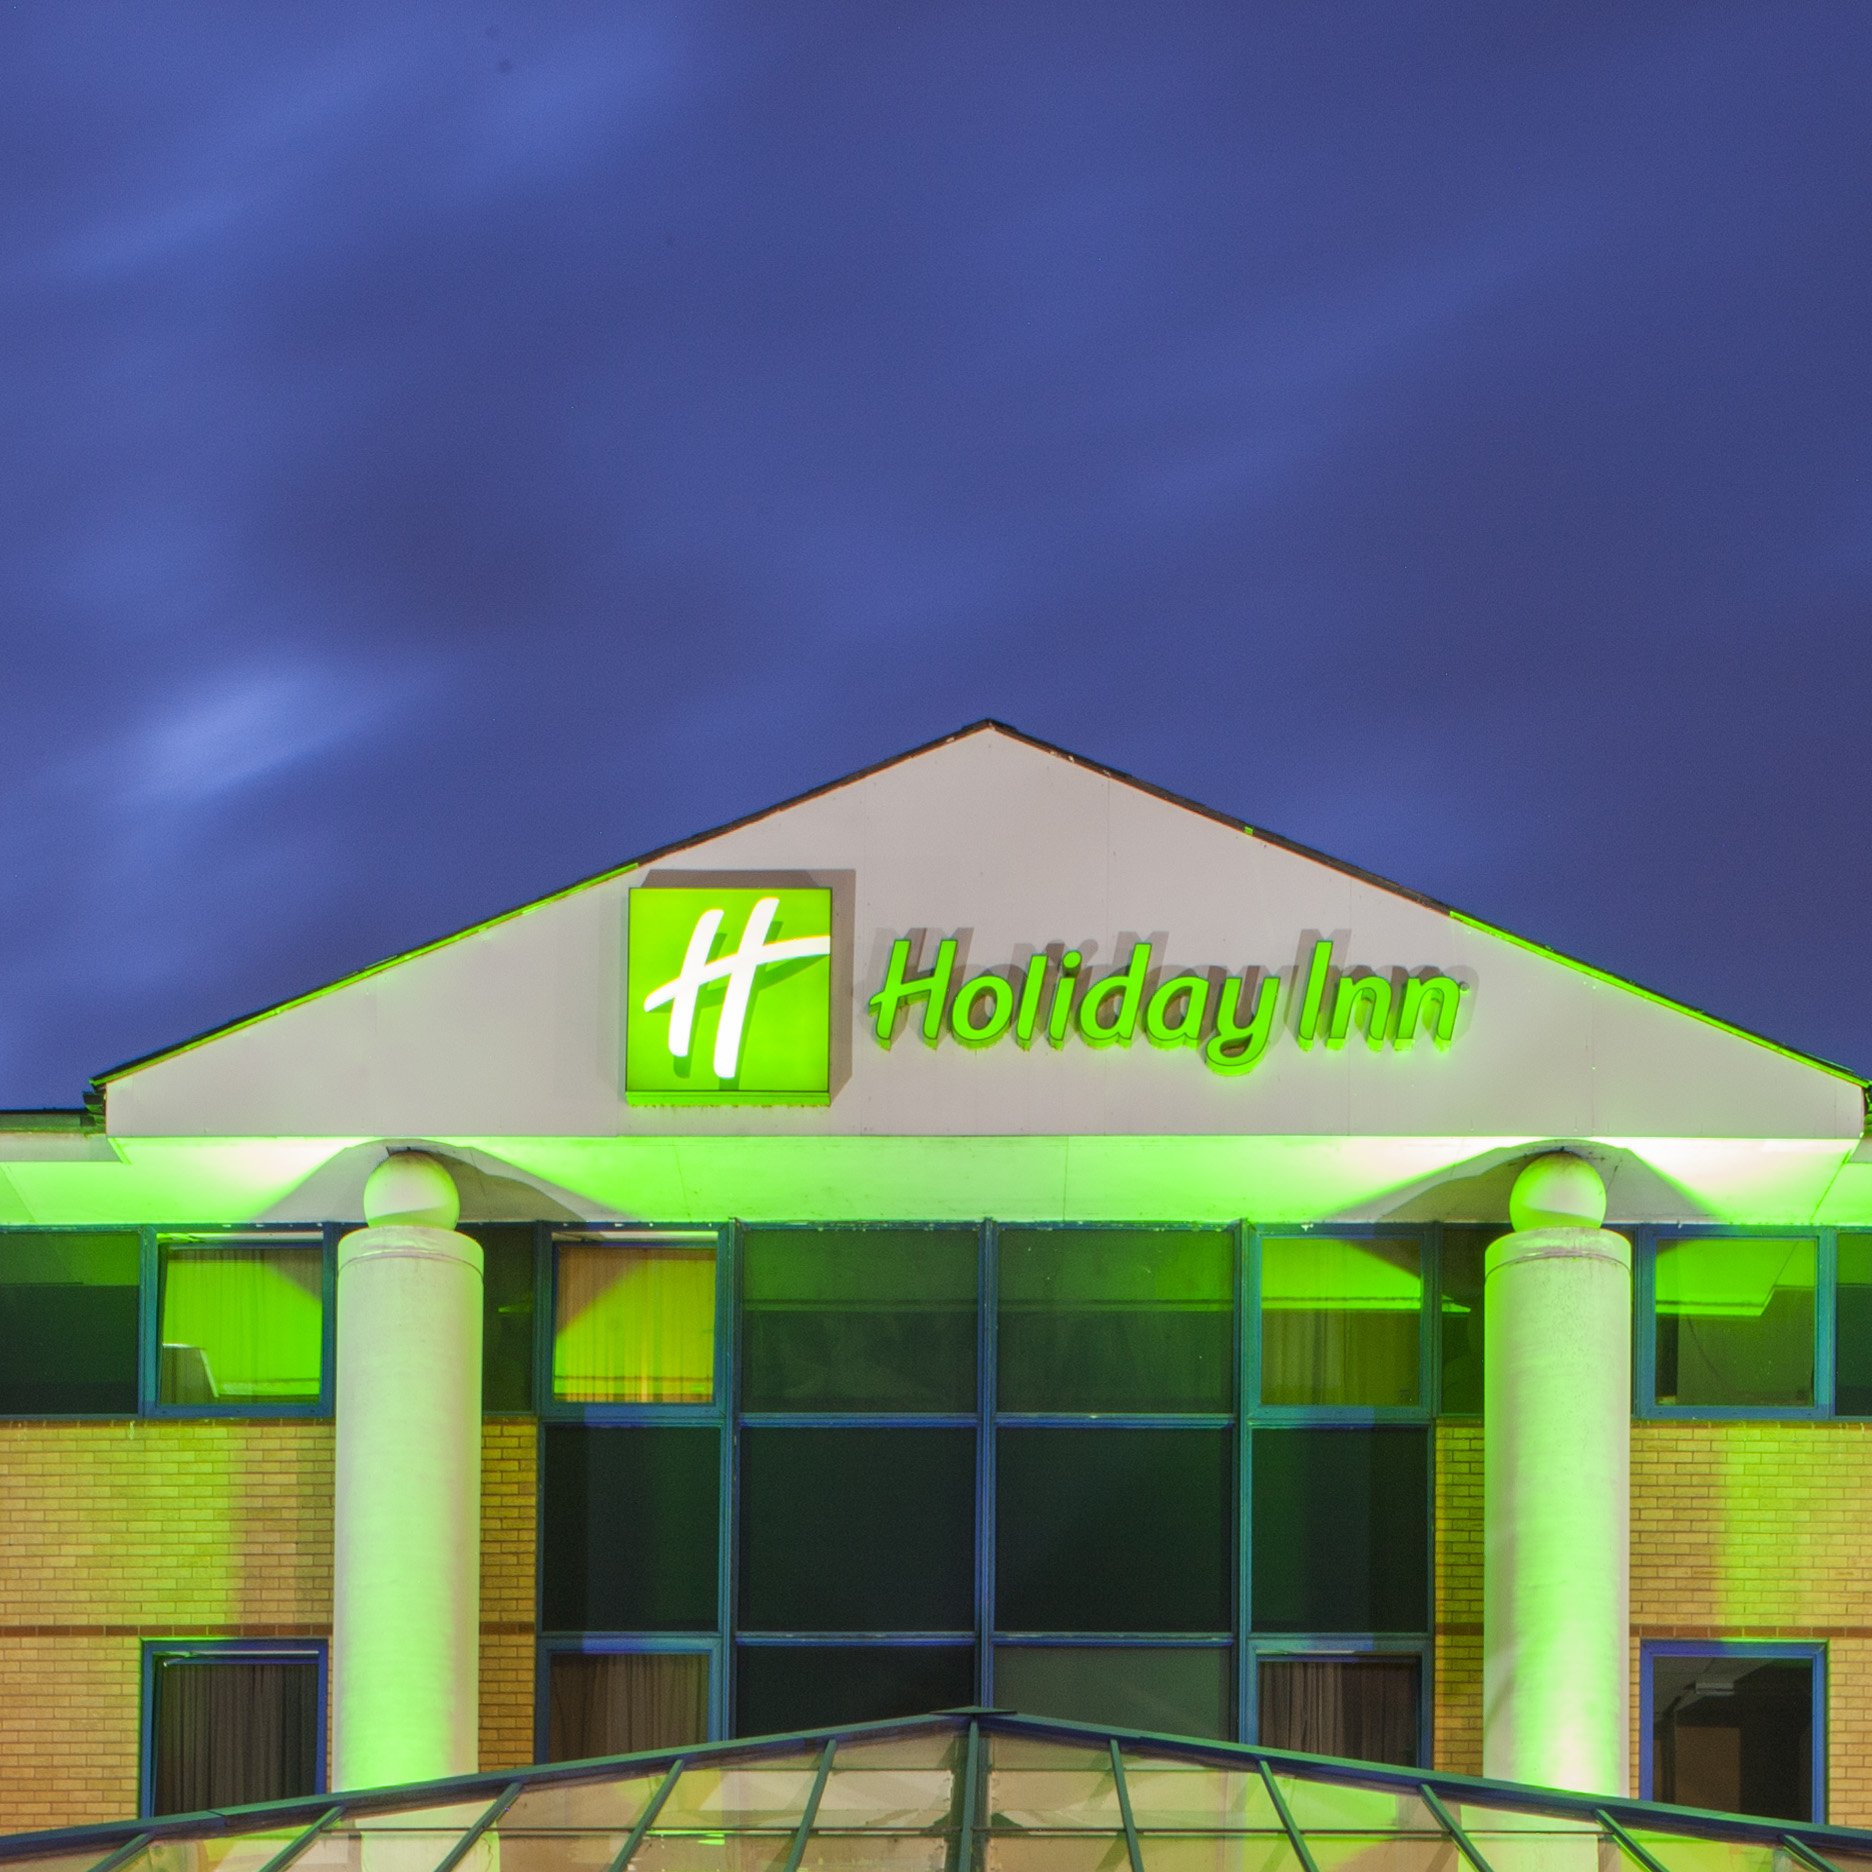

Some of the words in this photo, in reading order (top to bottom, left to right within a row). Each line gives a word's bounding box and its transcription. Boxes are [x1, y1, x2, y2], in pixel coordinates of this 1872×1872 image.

[643, 897, 830, 1079] H
[868, 937, 1281, 1077] Holiday
[1295, 939, 1463, 1053] Inn
